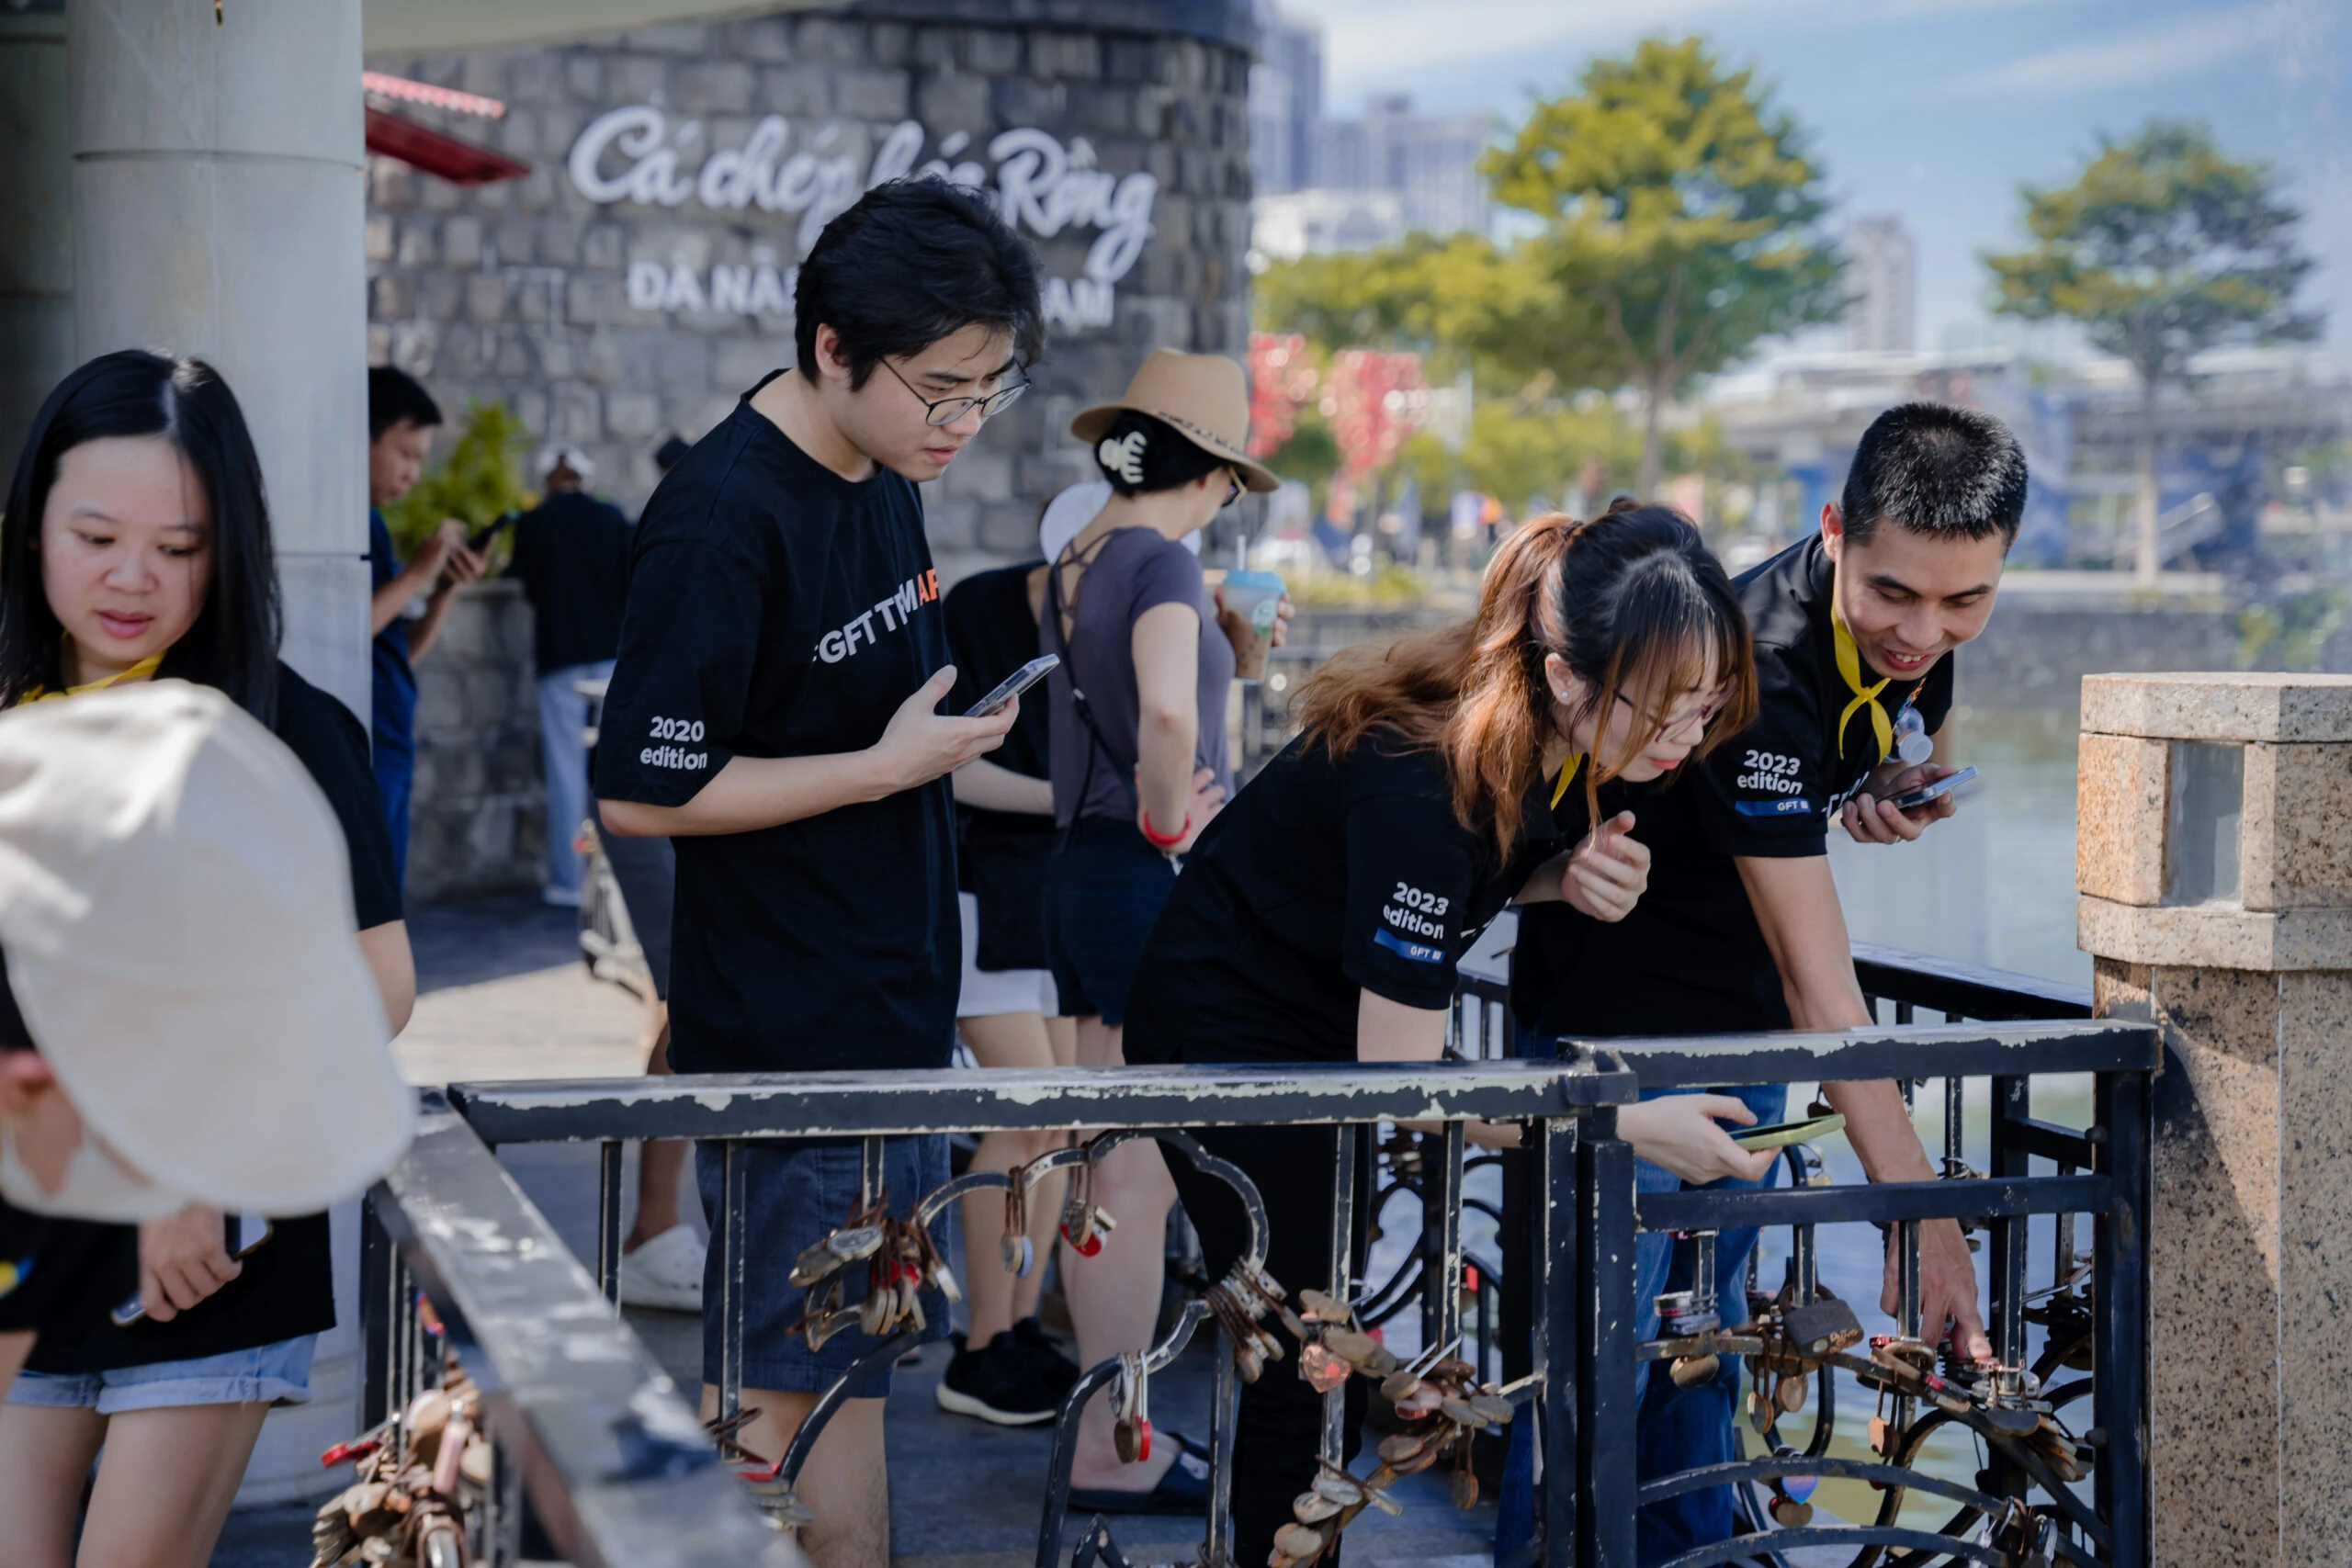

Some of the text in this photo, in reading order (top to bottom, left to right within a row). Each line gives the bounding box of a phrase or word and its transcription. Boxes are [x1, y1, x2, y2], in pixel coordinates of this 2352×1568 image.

[569, 105, 693, 207] Cá
[650, 716, 705, 742] 2020
[639, 745, 708, 771] edition
[1744, 749, 1801, 776] 2023
[1736, 771, 1803, 795] edition
[1777, 800, 1798, 811] GFT
[1393, 881, 1450, 916] 2023
[1383, 904, 1444, 940] edition
[1410, 945, 1431, 959] GFT
